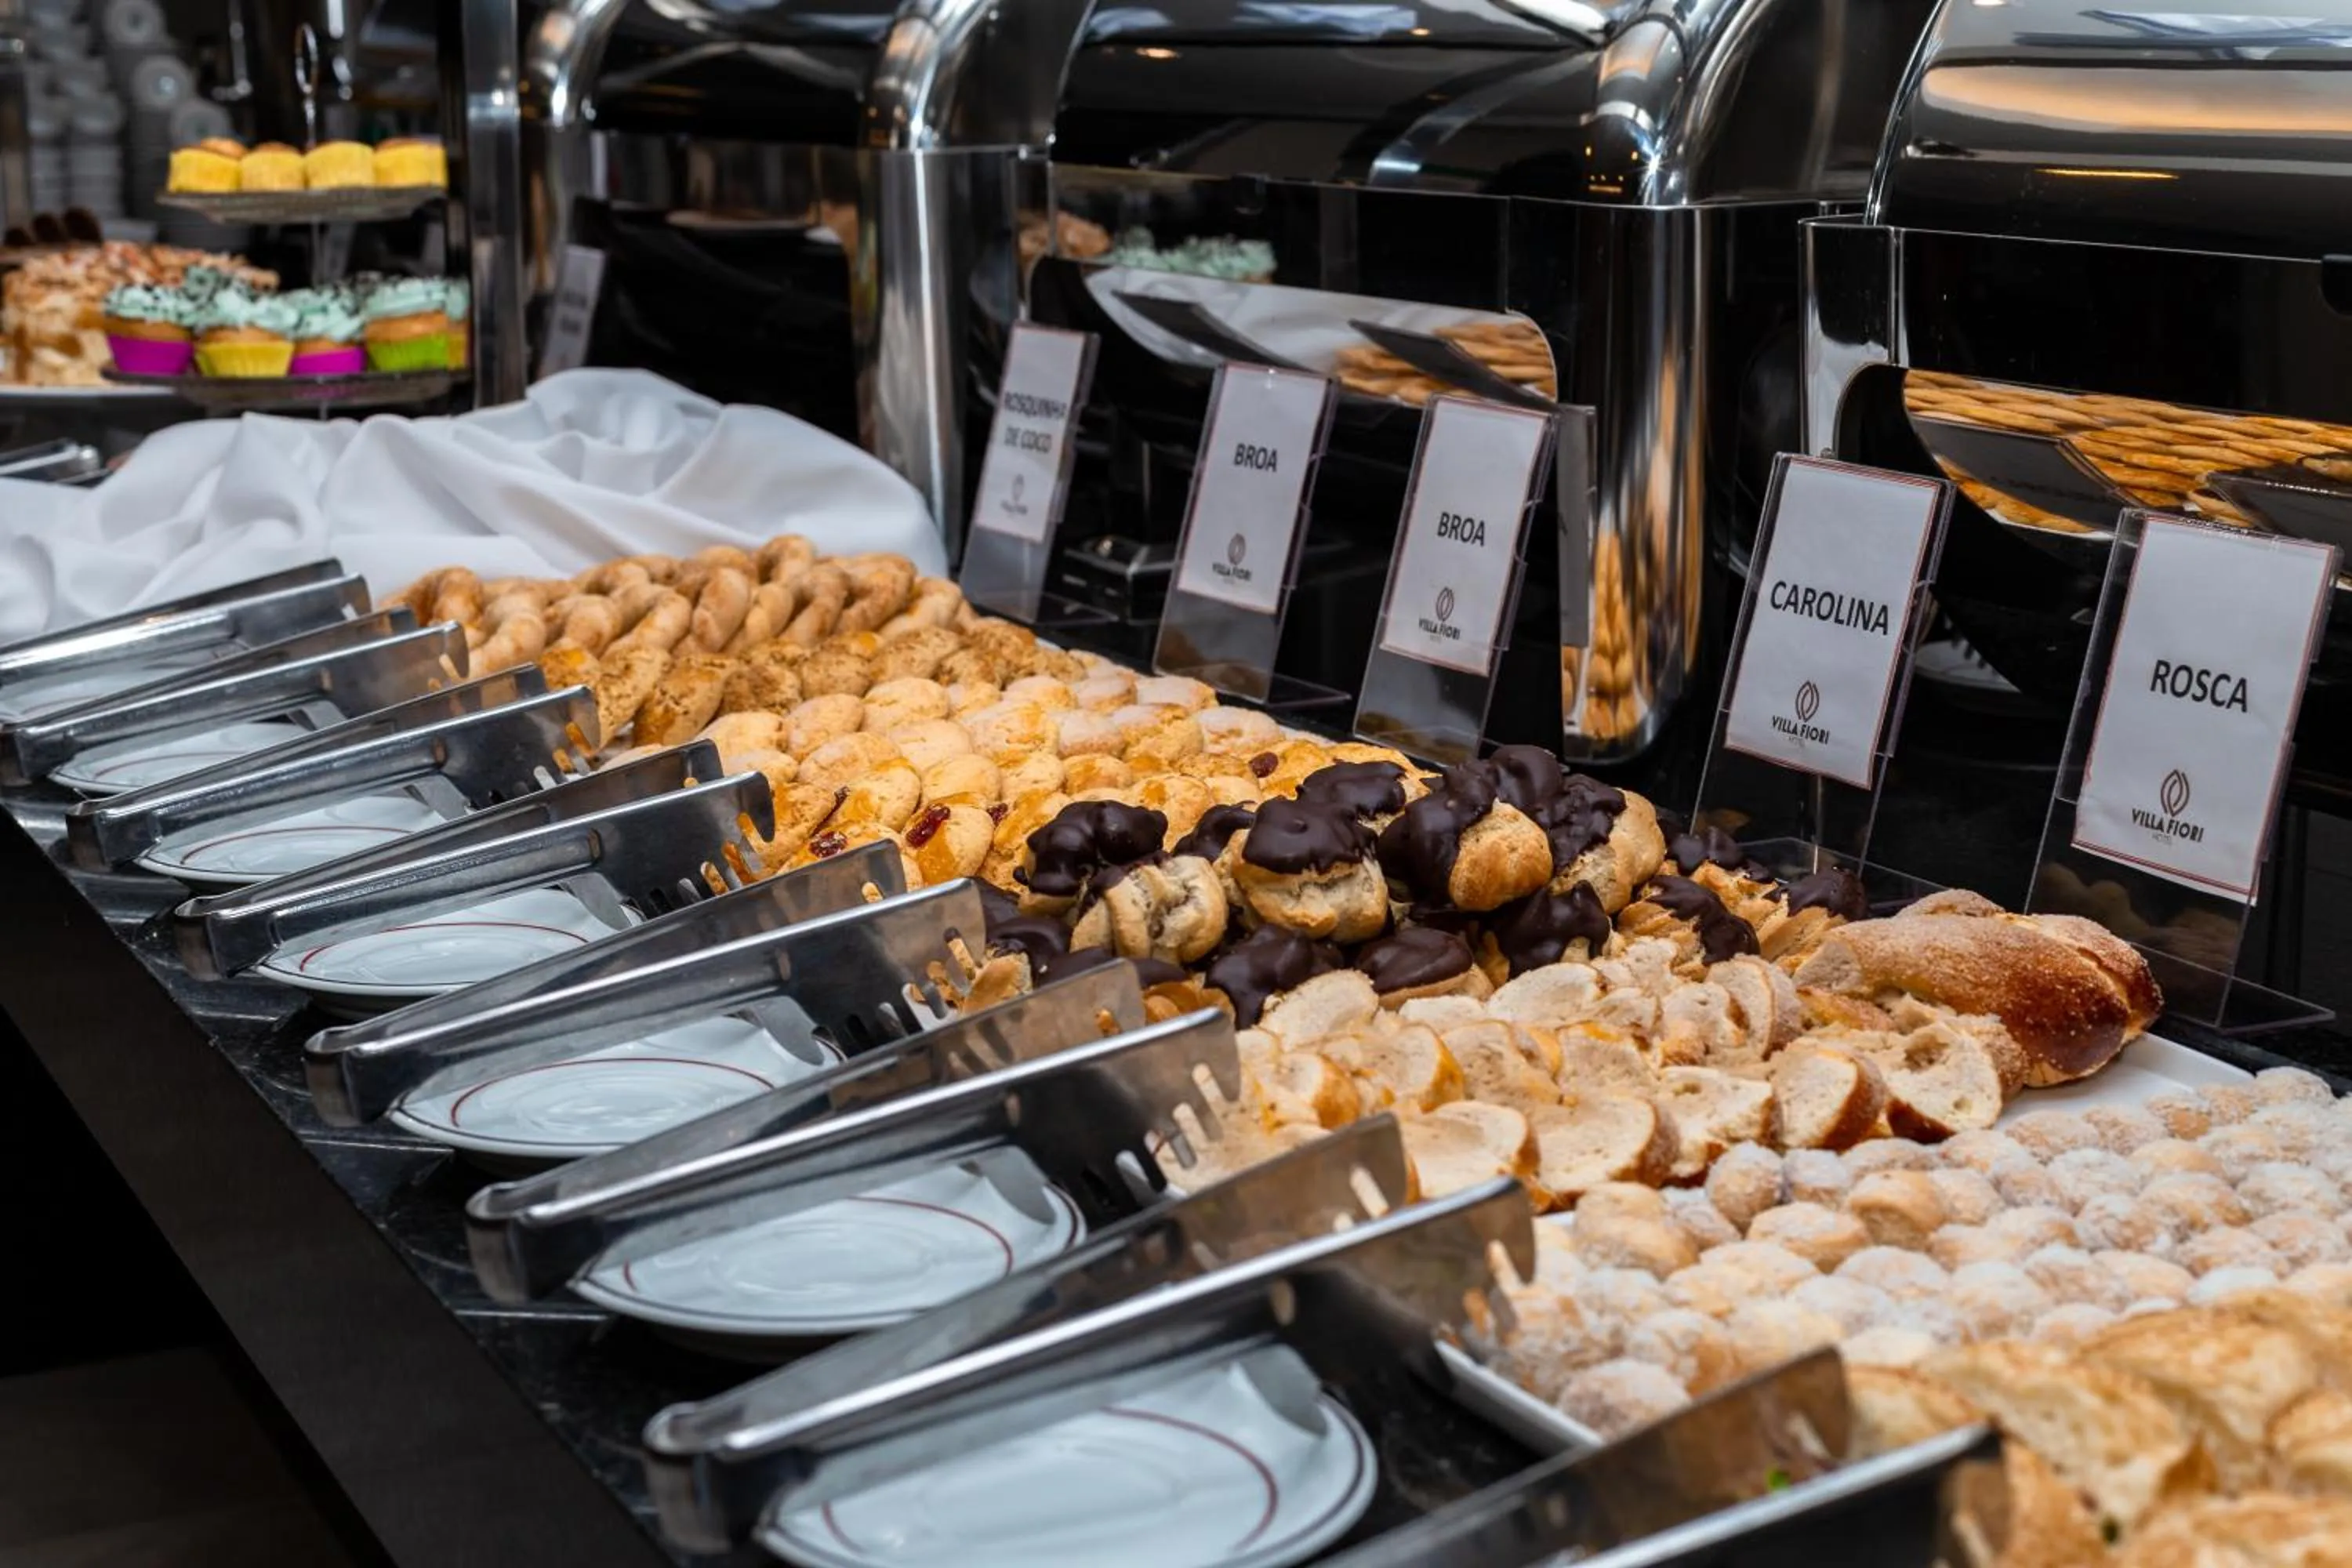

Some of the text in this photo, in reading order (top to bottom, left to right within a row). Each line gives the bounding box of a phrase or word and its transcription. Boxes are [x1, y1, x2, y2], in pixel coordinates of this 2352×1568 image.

[1233, 443, 1278, 472] BROA
[1437, 511, 1486, 546] BROA
[1770, 580, 1889, 636] CAROLINA
[2150, 659, 2249, 713] ROSCA
[1772, 714, 1798, 736] VILLA
[1800, 724, 1830, 746] FIORI
[2132, 808, 2205, 843] VILLA FIORI
